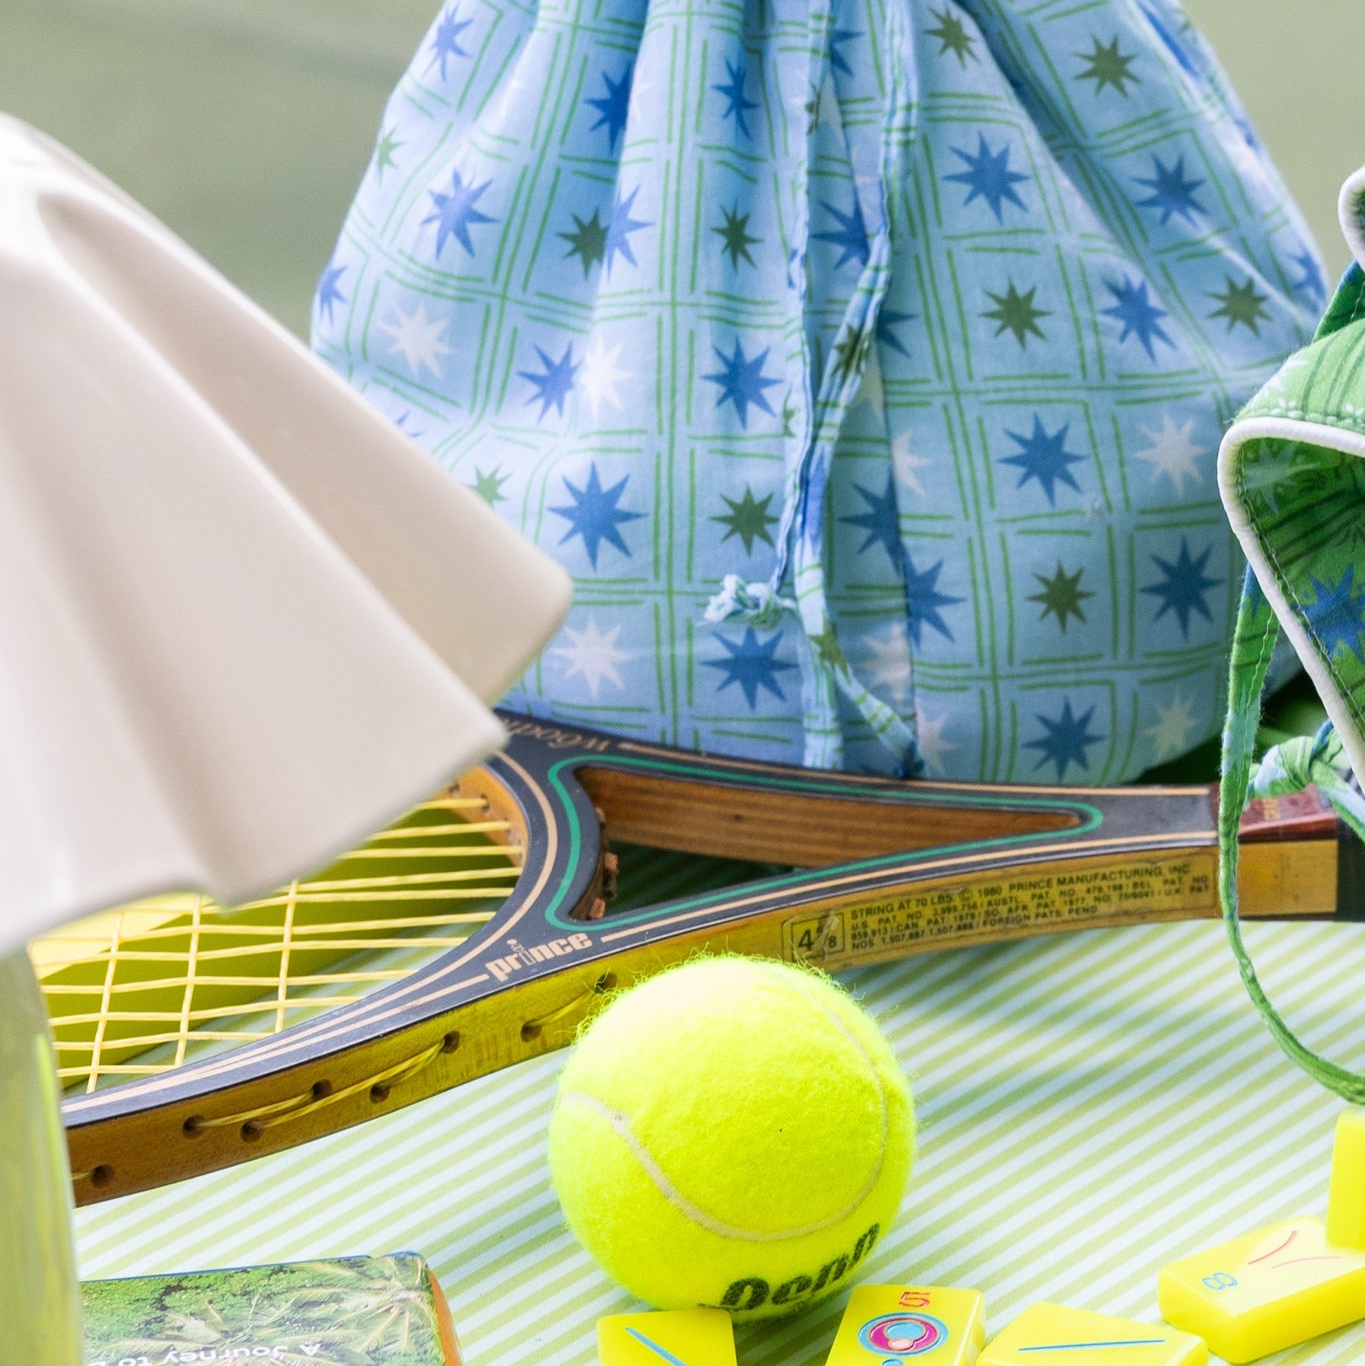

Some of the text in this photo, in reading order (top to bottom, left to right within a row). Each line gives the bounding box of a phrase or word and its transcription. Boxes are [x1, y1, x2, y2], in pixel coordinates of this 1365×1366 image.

[851, 903, 895, 920] STRING
[898, 899, 911, 911] AT
[1008, 877, 1053, 893] PRINCE
[1201, 1271, 1239, 1292] 8
[898, 1290, 931, 1308] 5
[161, 1343, 290, 1366] Journey
[299, 1340, 323, 1357] A
